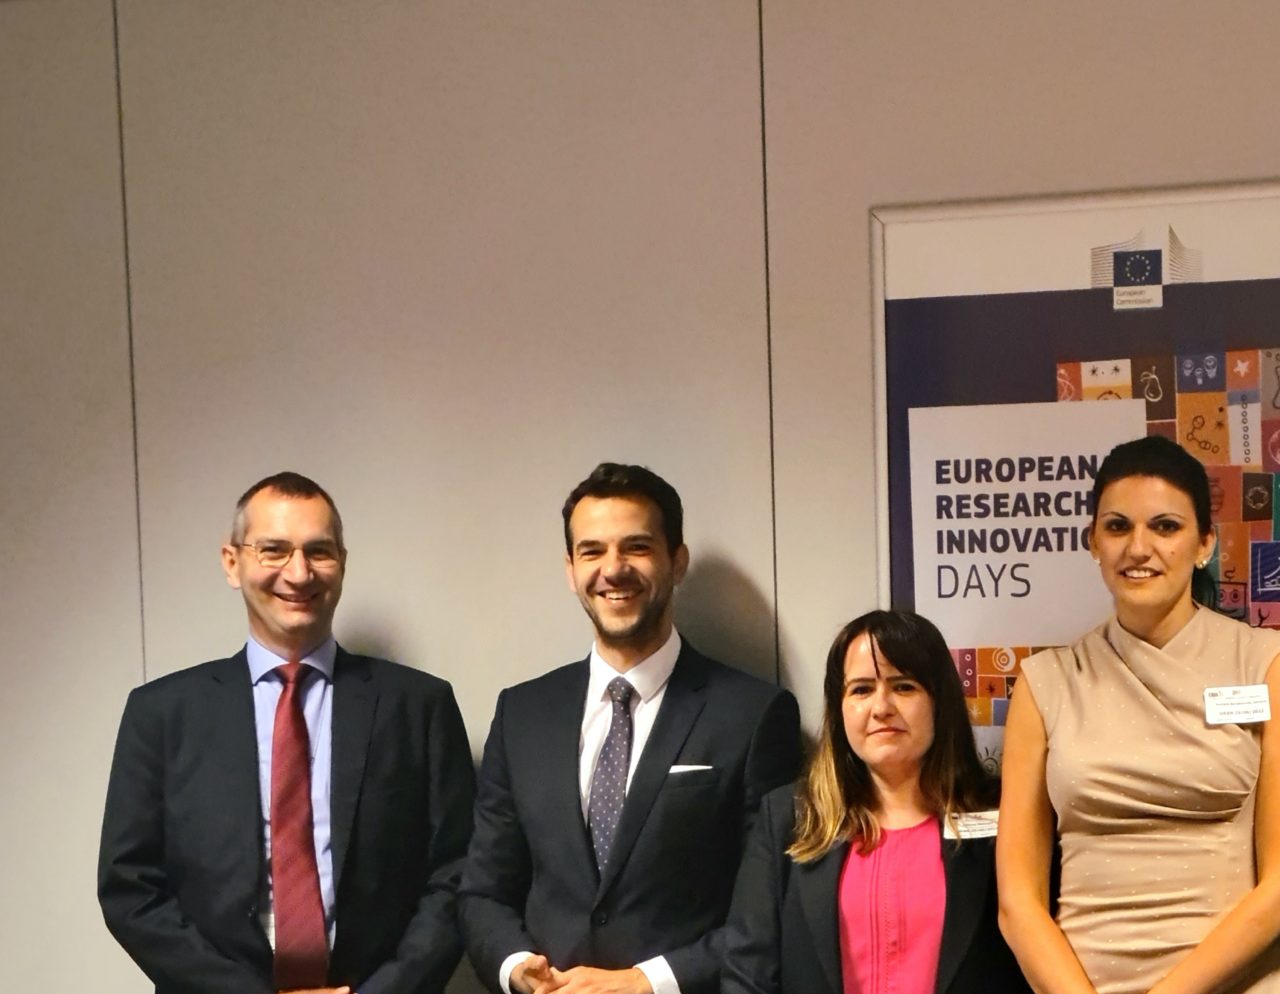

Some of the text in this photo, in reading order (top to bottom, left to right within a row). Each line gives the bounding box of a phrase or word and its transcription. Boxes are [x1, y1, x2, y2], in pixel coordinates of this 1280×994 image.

[935, 455, 1098, 484] EUROPEAN
[936, 491, 1095, 519] RESEARCH
[936, 527, 1091, 554] INNOVATI
[937, 563, 1031, 598] DAYS
